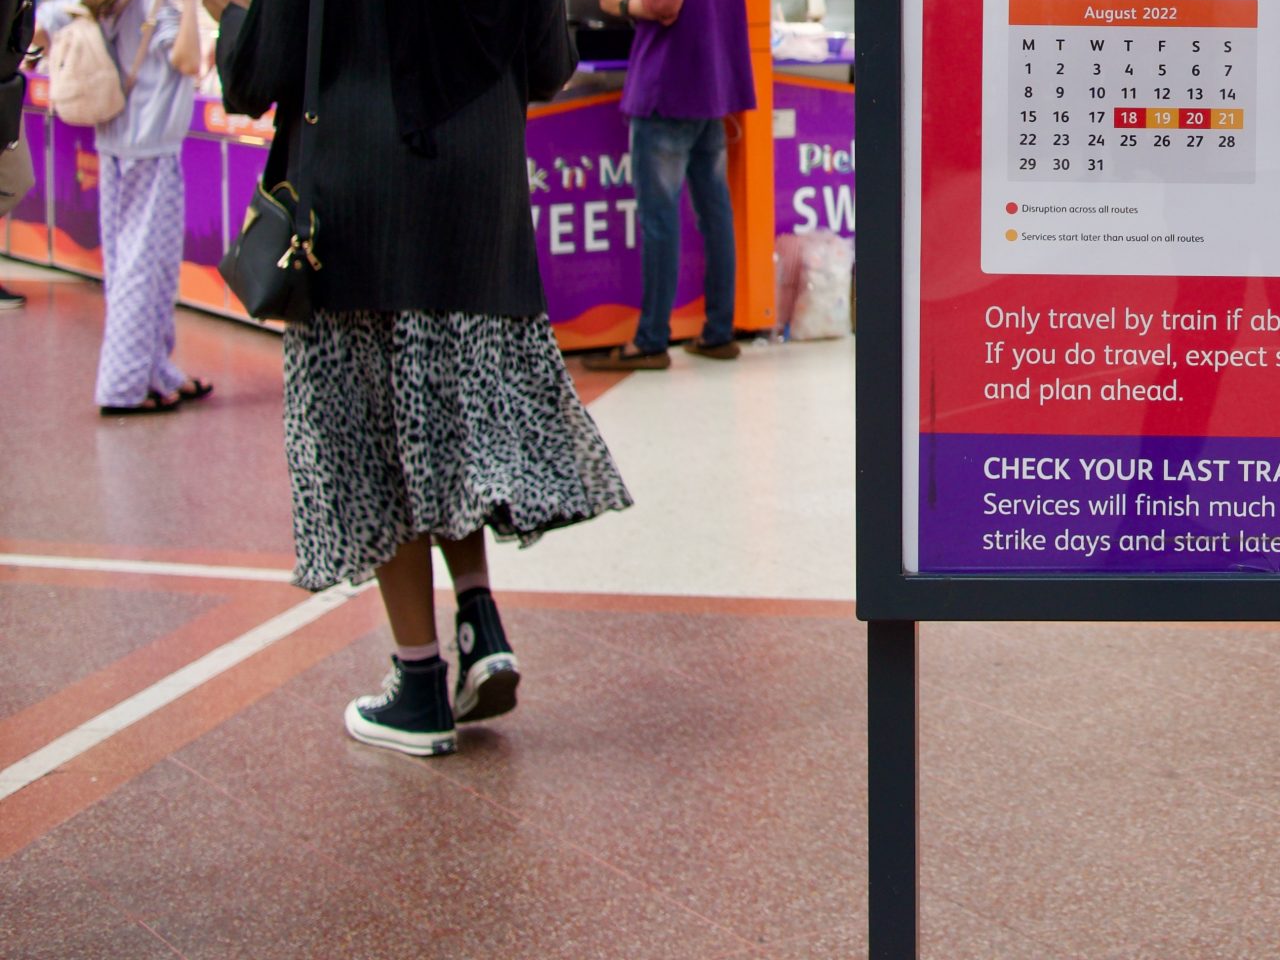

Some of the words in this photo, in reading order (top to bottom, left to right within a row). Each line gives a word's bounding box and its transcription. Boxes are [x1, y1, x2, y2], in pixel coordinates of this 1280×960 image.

[1085, 6, 1136, 22] August
[1143, 8, 1176, 19] 2022
[1023, 39, 1034, 50] M
[1056, 40, 1065, 50] T
[1090, 40, 1104, 51] W
[1124, 40, 1133, 51] T
[1159, 41, 1166, 51] F
[1193, 41, 1200, 52] S
[1224, 41, 1231, 52] S
[1026, 63, 1030, 74] 1
[1057, 63, 1064, 74] 2
[1094, 64, 1100, 75] 3
[1125, 64, 1133, 75] 4
[1159, 65, 1166, 76] 5
[1192, 65, 1200, 76] 6
[1225, 65, 1232, 76] 7
[1025, 87, 1032, 98] 8
[1056, 87, 1064, 98] 9
[1089, 87, 1105, 98] 10
[1122, 88, 1135, 99] 11
[1154, 88, 1170, 99] 12
[1188, 88, 1203, 99] 13
[1220, 89, 1235, 100] 14
[1021, 111, 1036, 122] 15
[1053, 111, 1069, 122] 16
[1089, 112, 1105, 123] 17
[1121, 112, 1137, 123] 18
[1155, 113, 1170, 124] 19
[1187, 113, 1203, 124] 20
[1219, 113, 1233, 124] 21
[1020, 134, 1036, 145] 22
[1054, 134, 1069, 145] 23
[1088, 135, 1104, 145] 24
[1120, 135, 1136, 146] 25
[1154, 135, 1170, 147] 26
[1187, 136, 1203, 147] 27
[1219, 136, 1235, 147] 28
[1020, 158, 1036, 169] 29
[1053, 159, 1069, 170] 30
[1088, 159, 1102, 170] 31
[1022, 205, 1066, 214] Disruption
[1022, 232, 1056, 240] Services
[986, 306, 1040, 334] Only
[1048, 307, 1115, 329] travel
[1126, 307, 1153, 335] by
[1161, 310, 1216, 330] train
[1227, 308, 1243, 330] if
[986, 341, 1004, 363] If
[1012, 348, 1055, 370] you
[1065, 343, 1095, 364] do
[1104, 344, 1176, 368] travel,
[1186, 347, 1267, 372] expect
[985, 378, 1029, 399] and
[1040, 378, 1091, 405] plan
[1101, 379, 1183, 401] ahead.
[984, 457, 1070, 479] CHECK
[1080, 459, 1153, 480] YOUR
[1164, 460, 1230, 481] LAST
[984, 493, 1080, 515] Services
[1089, 494, 1125, 515] will
[1135, 494, 1199, 516] finish
[1210, 496, 1274, 517] much
[983, 528, 1046, 550] strike
[1055, 529, 1110, 556] days
[1120, 529, 1164, 551] and
[1174, 532, 1230, 551] start
